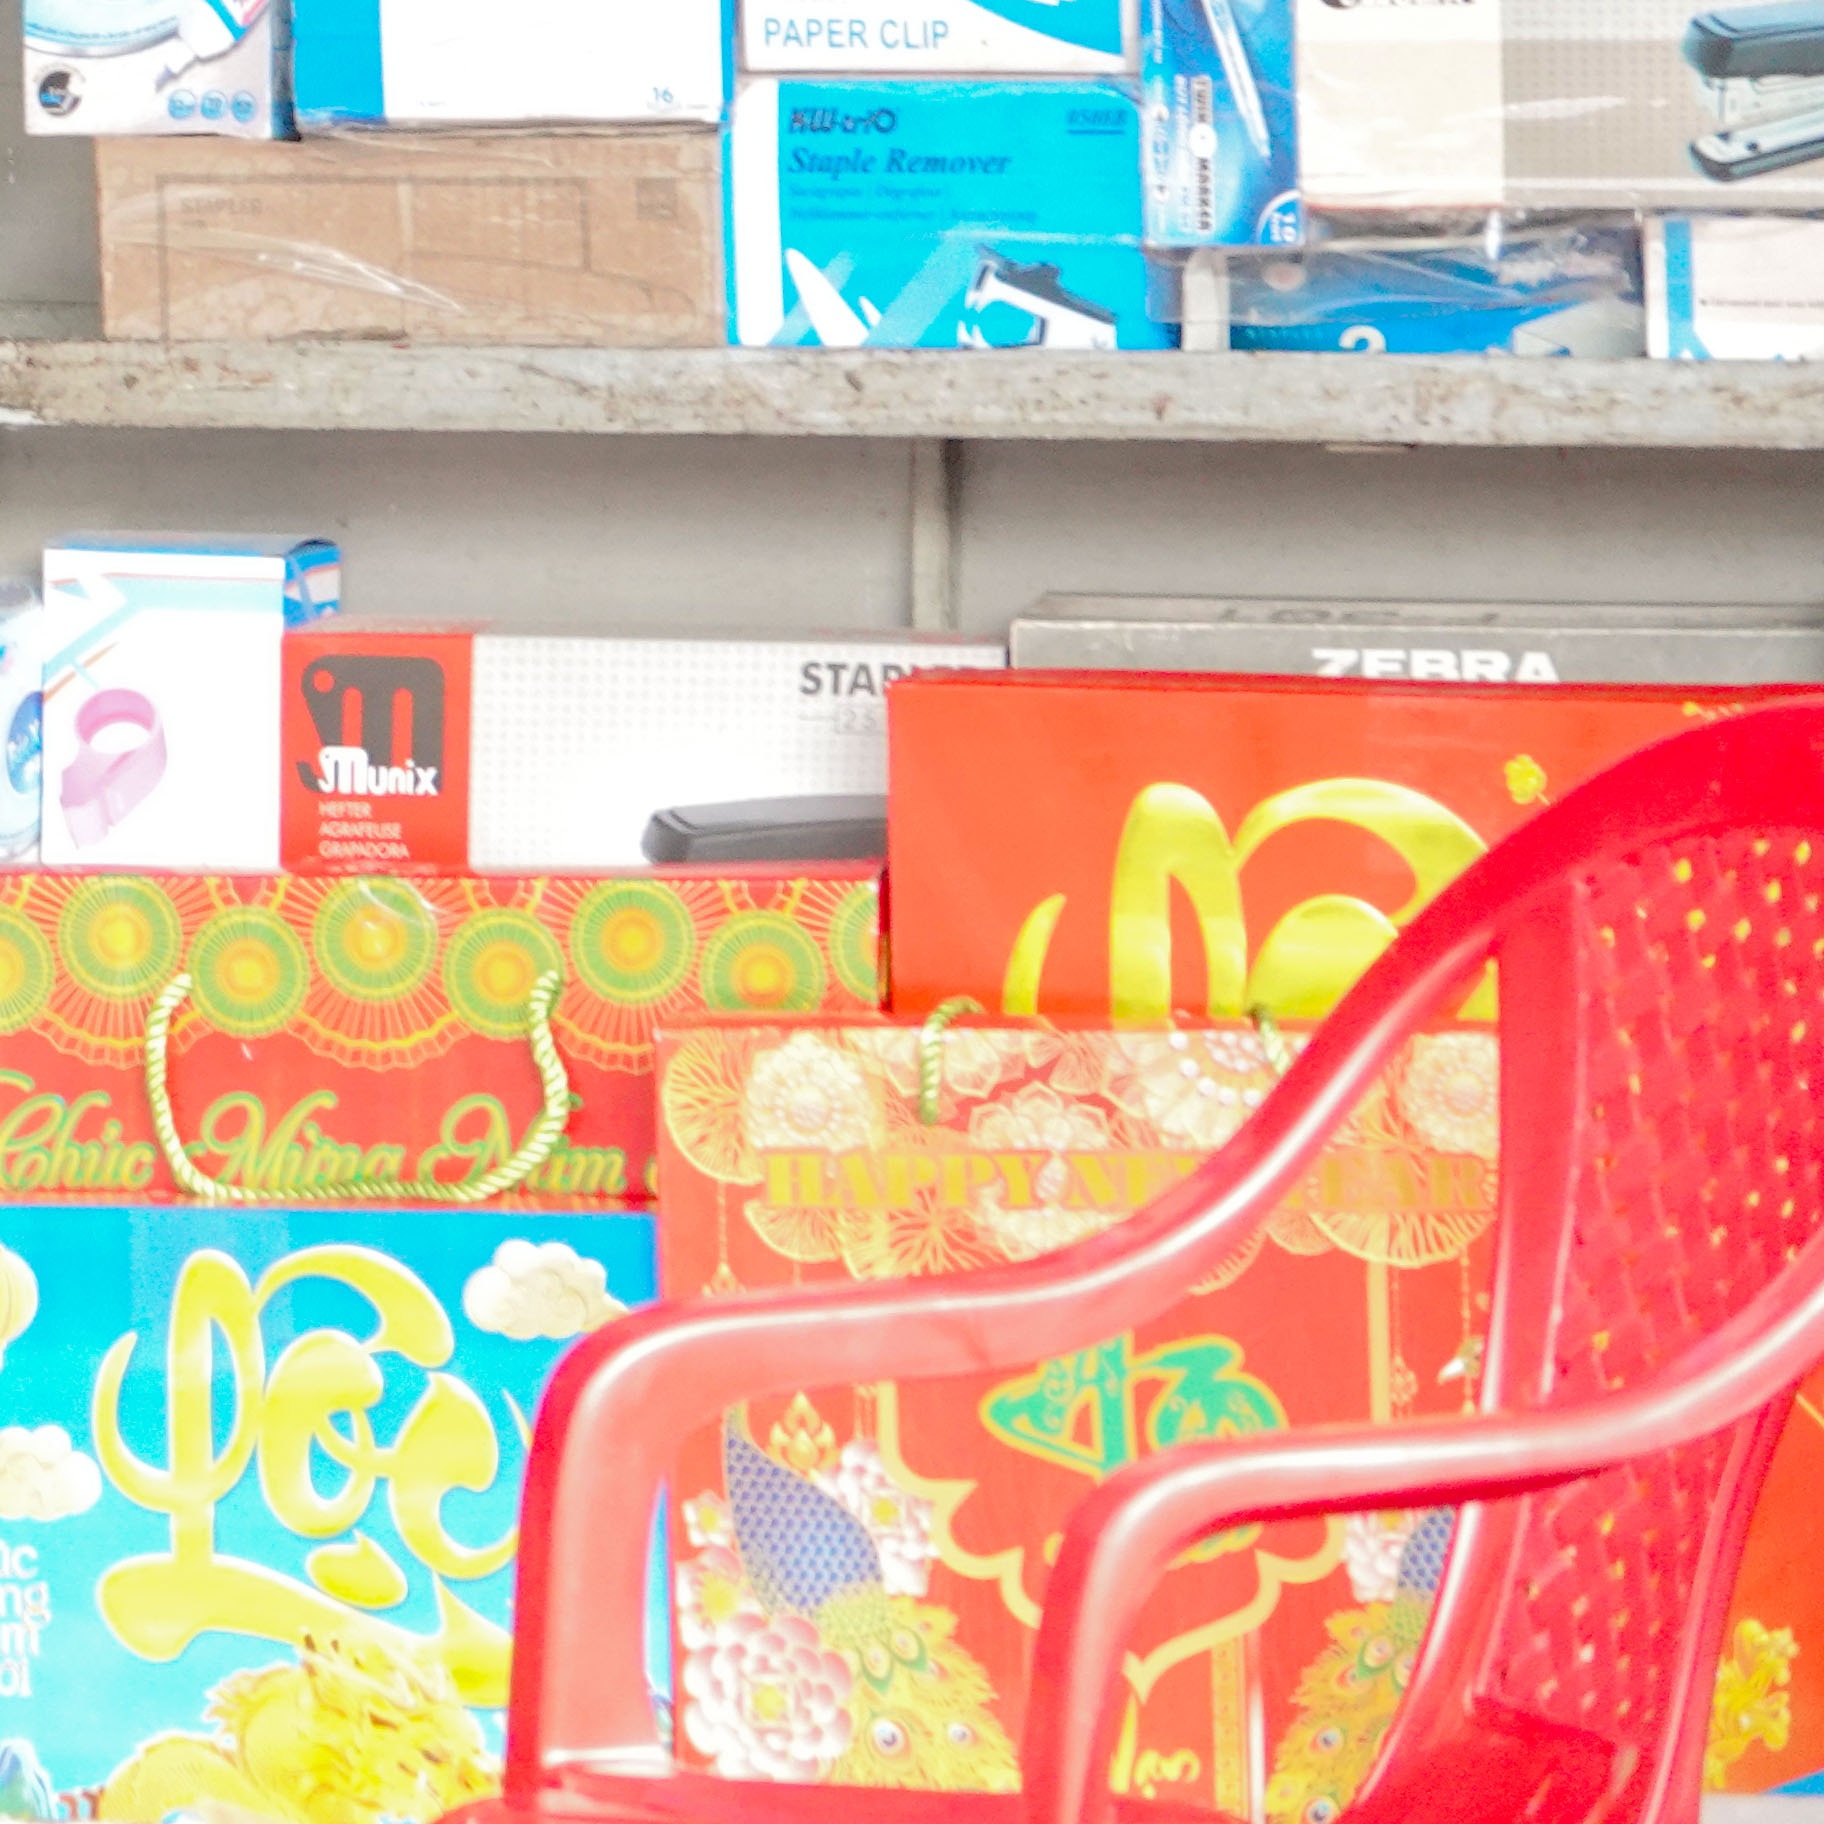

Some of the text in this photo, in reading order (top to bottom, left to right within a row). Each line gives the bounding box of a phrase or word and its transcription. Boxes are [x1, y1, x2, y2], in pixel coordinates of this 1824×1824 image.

[764, 17, 949, 49] PAPER CLIP
[790, 146, 1012, 180] Staple Remover
[1311, 648, 1559, 683] ZEBRA
[765, 1149, 1051, 1213] HAPPY
